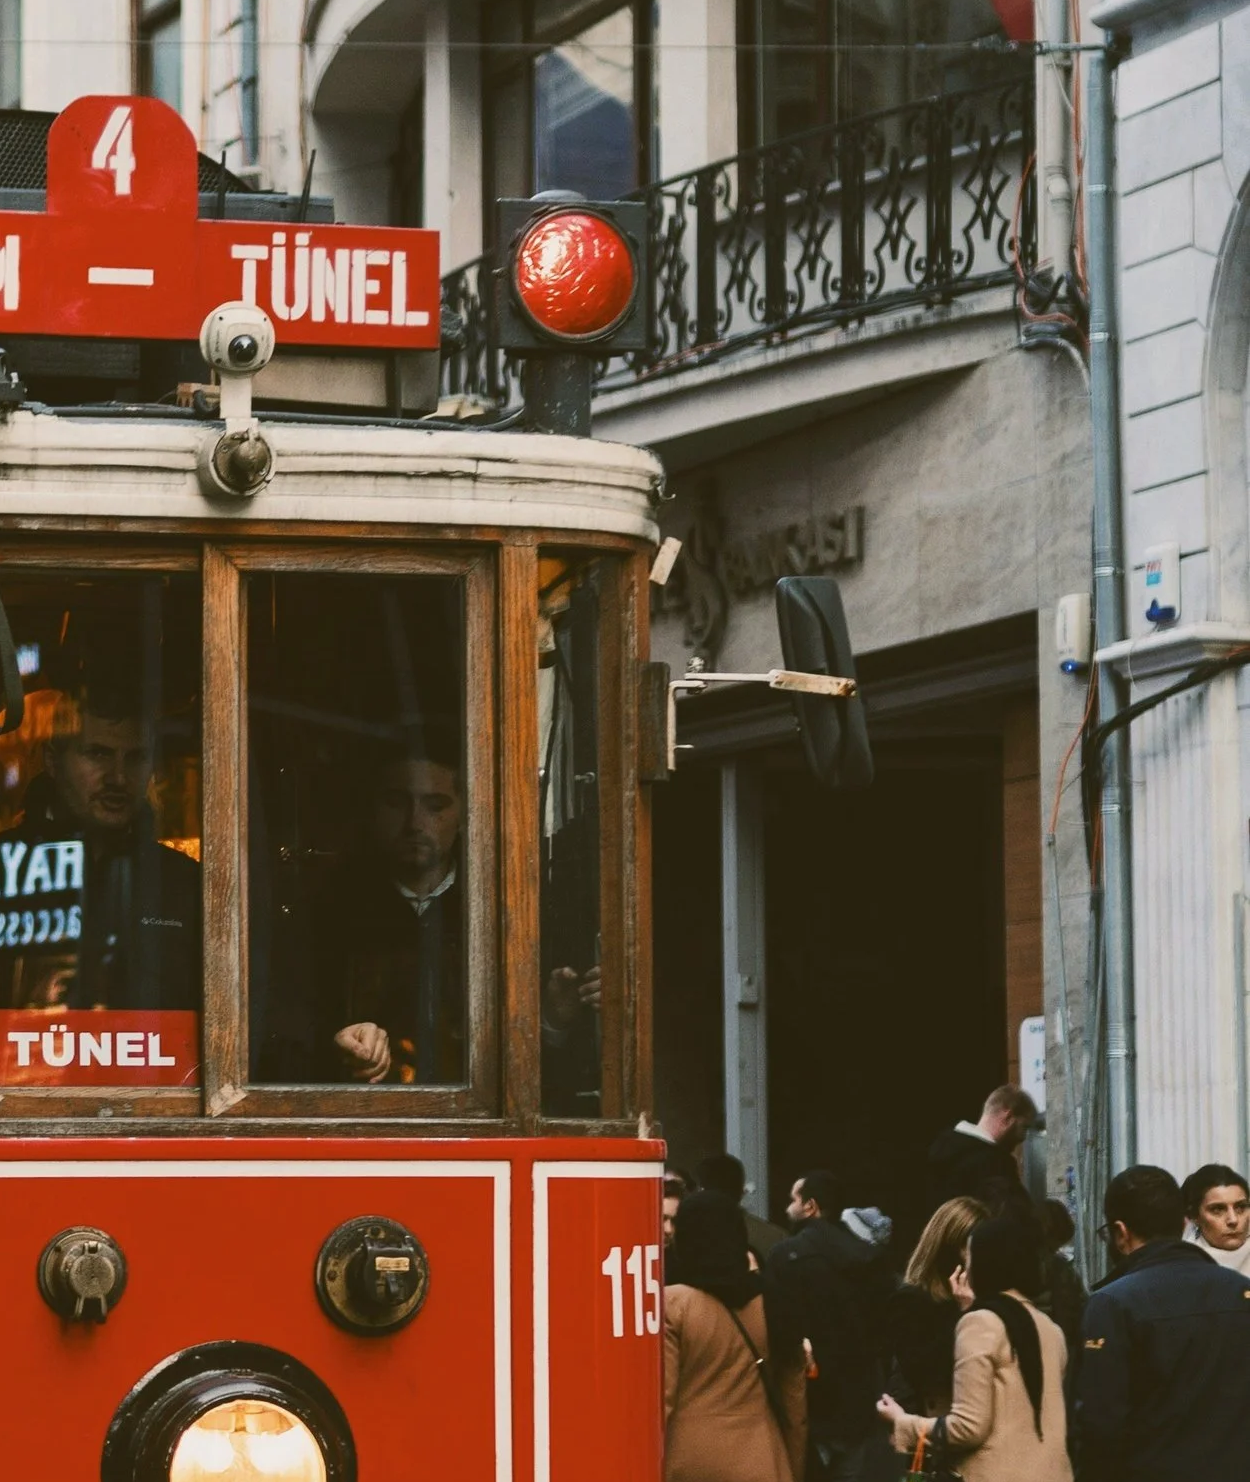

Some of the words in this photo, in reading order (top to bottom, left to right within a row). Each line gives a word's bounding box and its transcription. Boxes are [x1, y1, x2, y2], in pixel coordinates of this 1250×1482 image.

[91, 105, 136, 196] 4
[231, 232, 430, 327] TÜNEL
[7, 1024, 176, 1067] TÜNEL
[601, 1244, 661, 1338] 115
